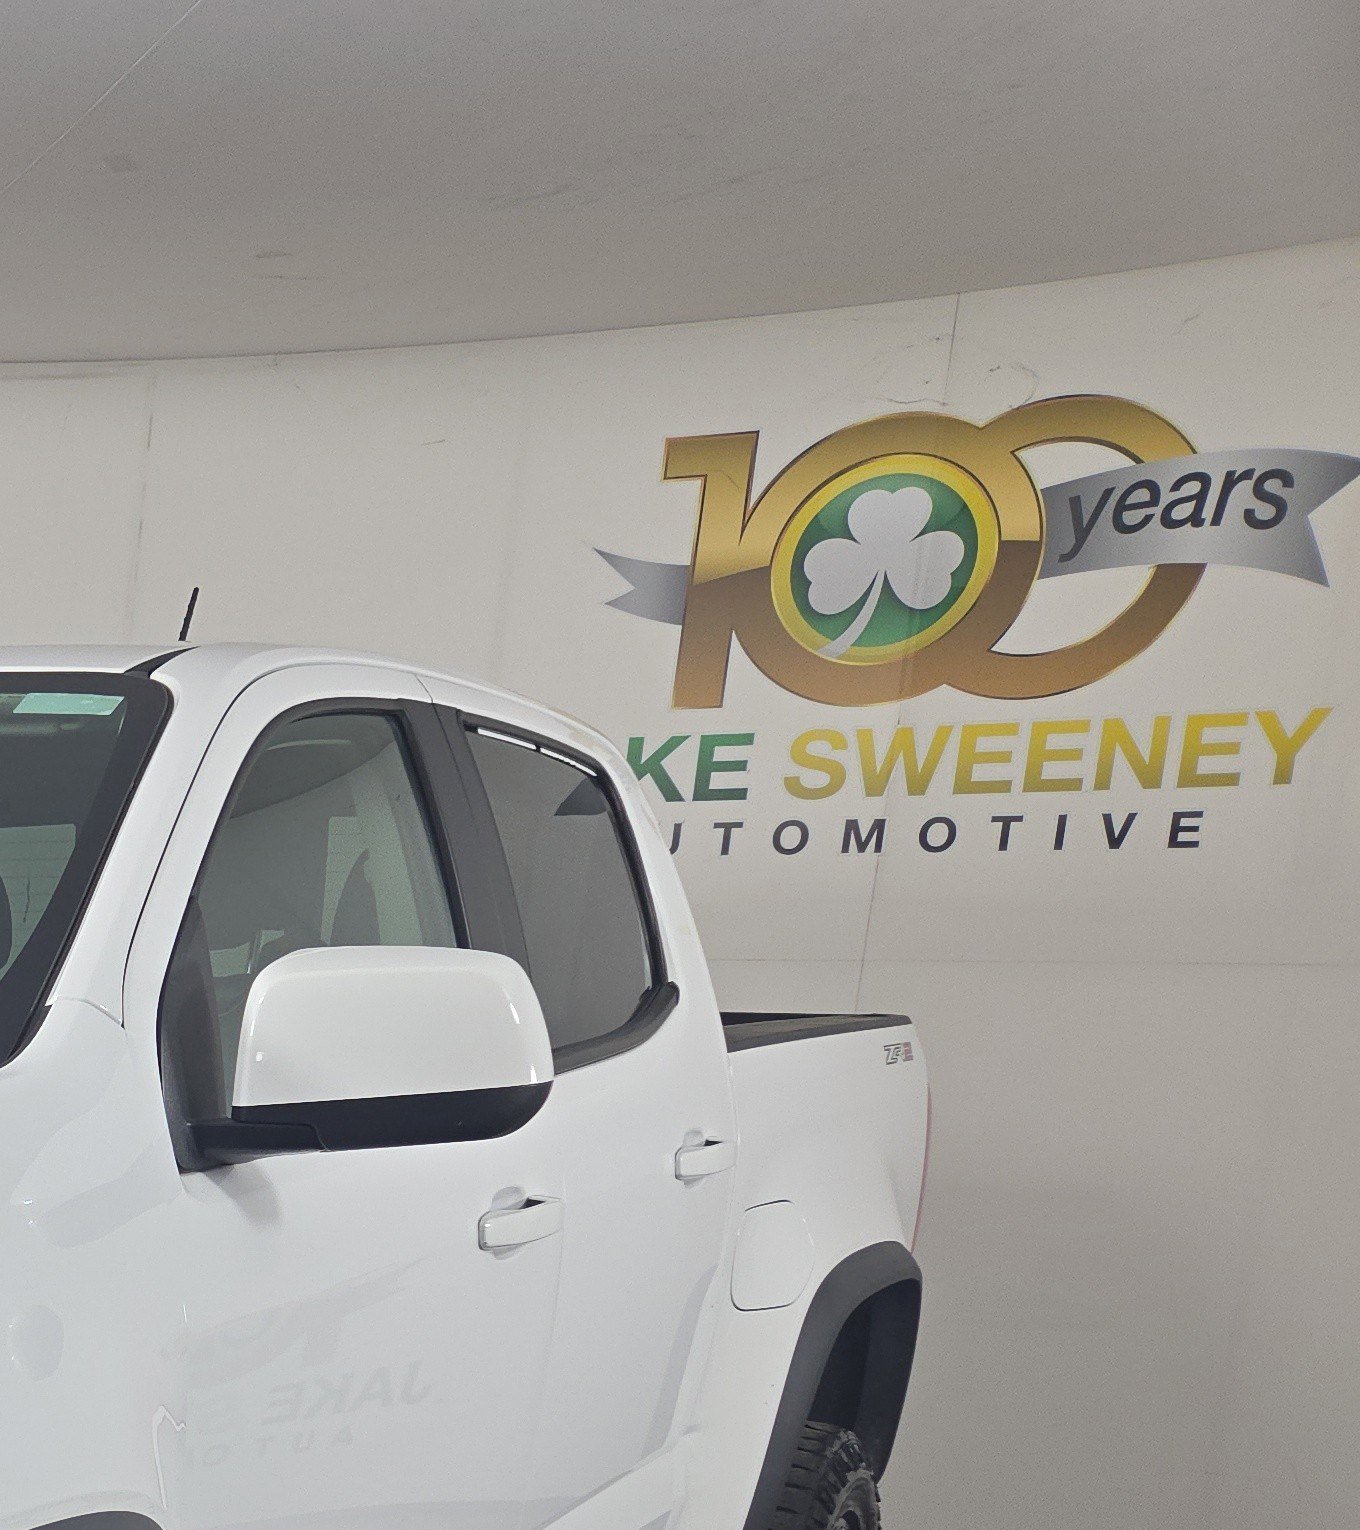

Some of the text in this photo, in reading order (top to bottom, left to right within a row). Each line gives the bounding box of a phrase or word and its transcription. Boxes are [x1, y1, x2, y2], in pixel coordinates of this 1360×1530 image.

[1058, 466, 1295, 562] years
[626, 706, 1334, 803] KE SWEENEY
[668, 810, 1204, 856] TOMOTIVE
